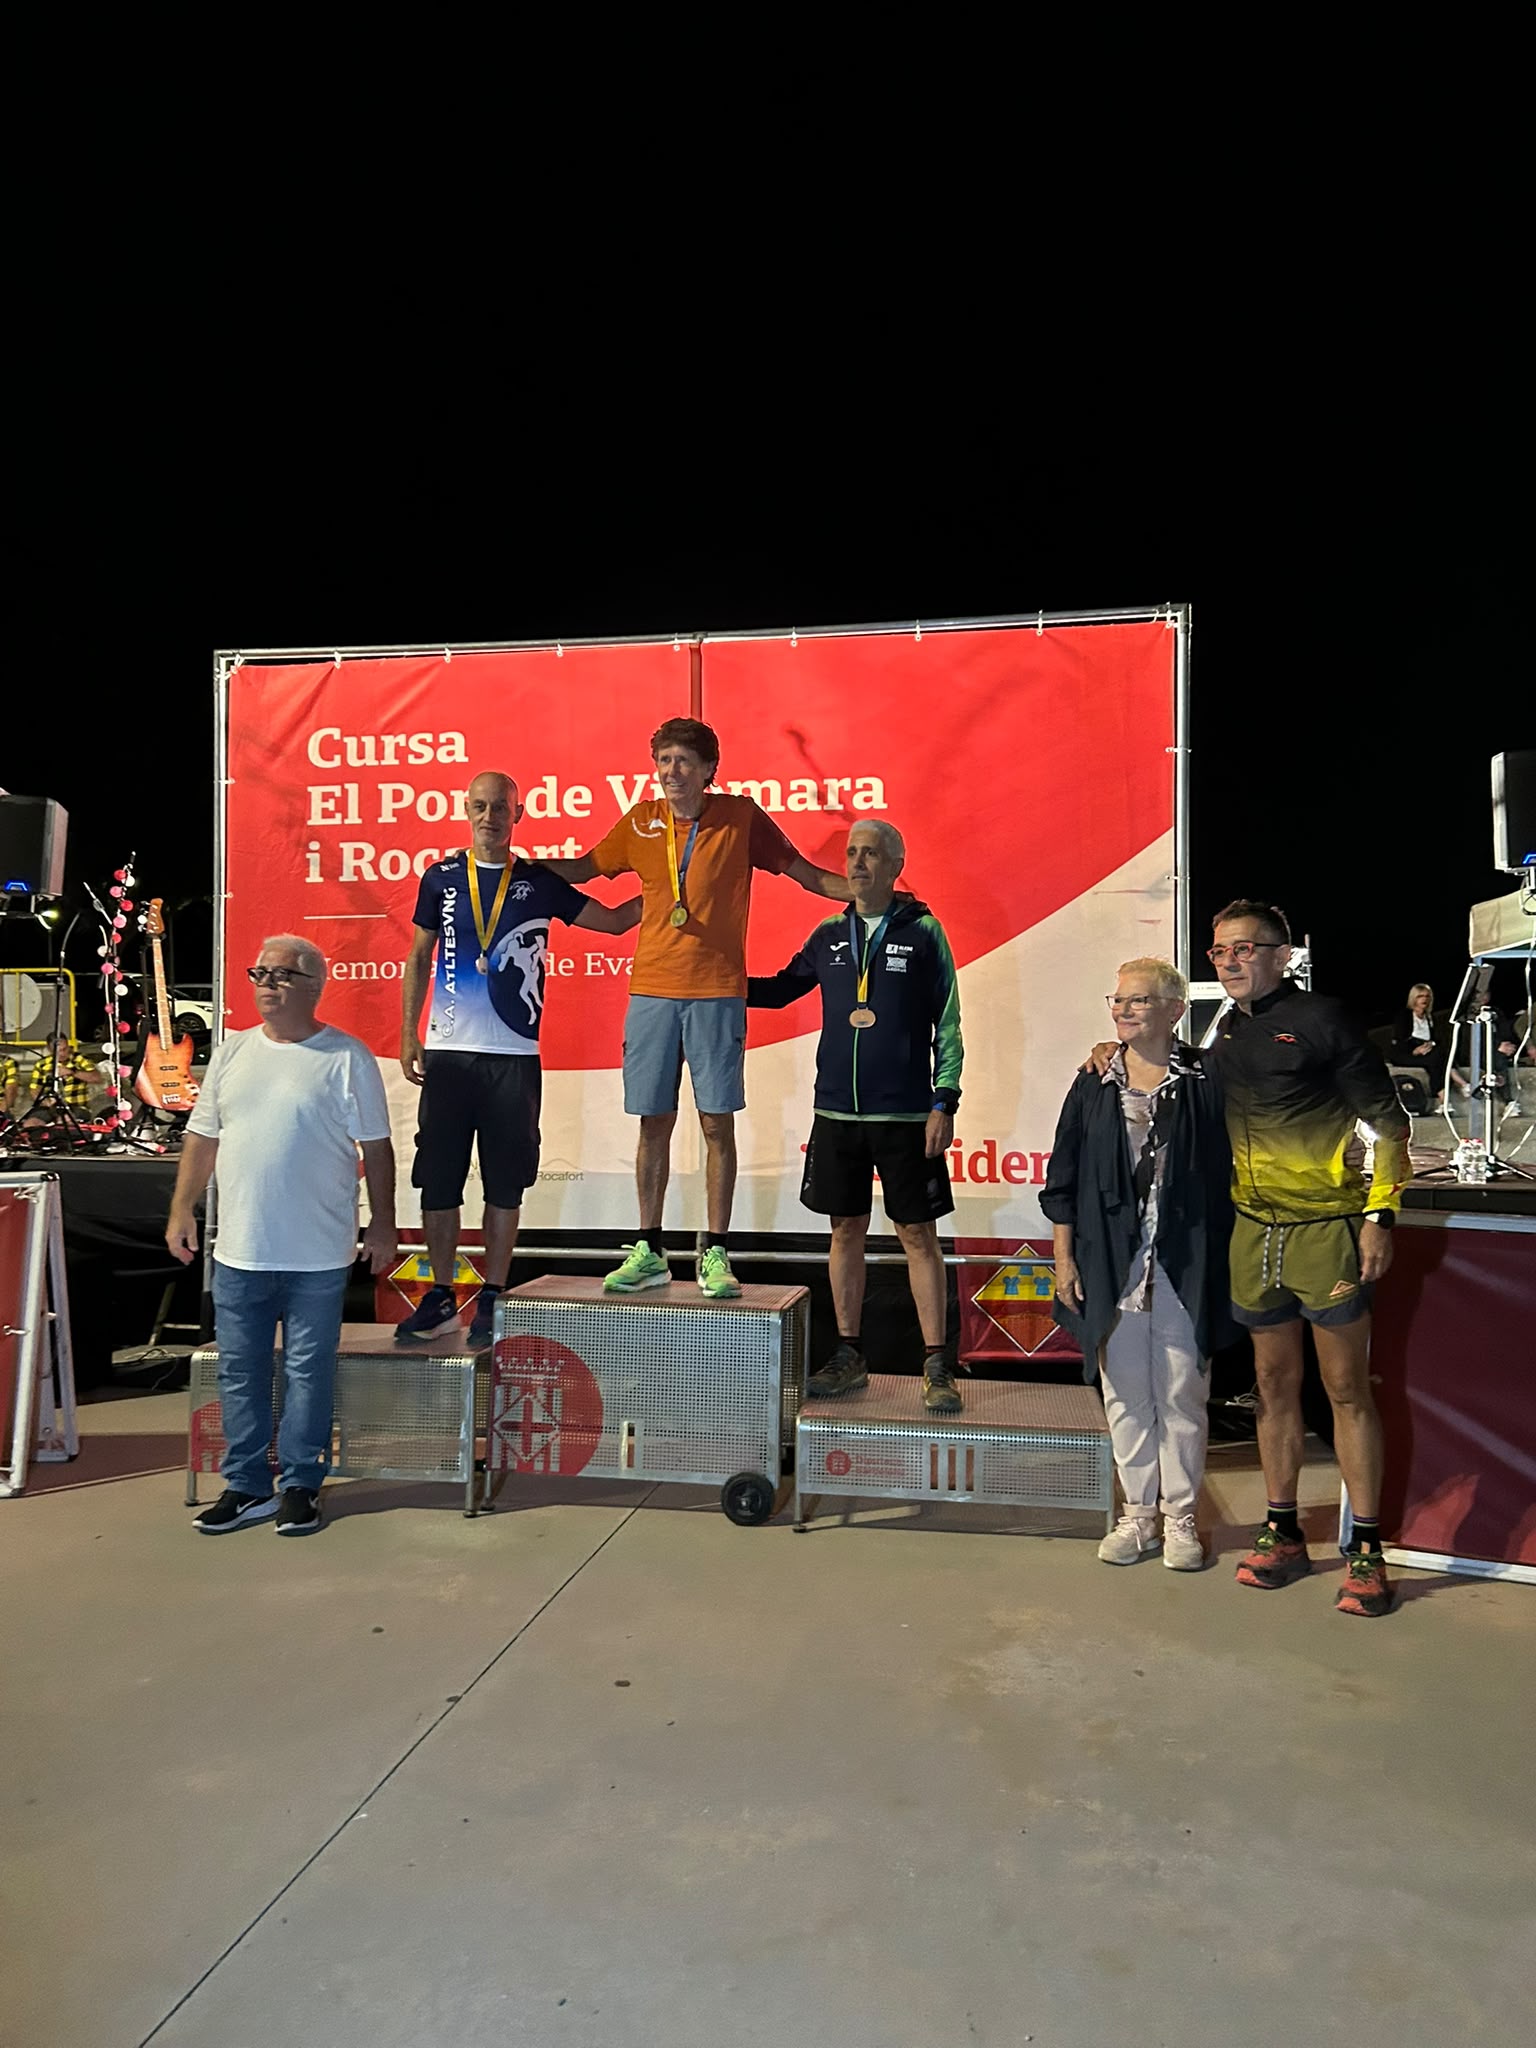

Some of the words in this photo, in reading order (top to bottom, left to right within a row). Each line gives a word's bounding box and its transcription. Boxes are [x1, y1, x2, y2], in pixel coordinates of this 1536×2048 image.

[307, 727, 469, 769] Cursa
[307, 783, 363, 826] El
[525, 776, 593, 818] de
[304, 841, 324, 883] i
